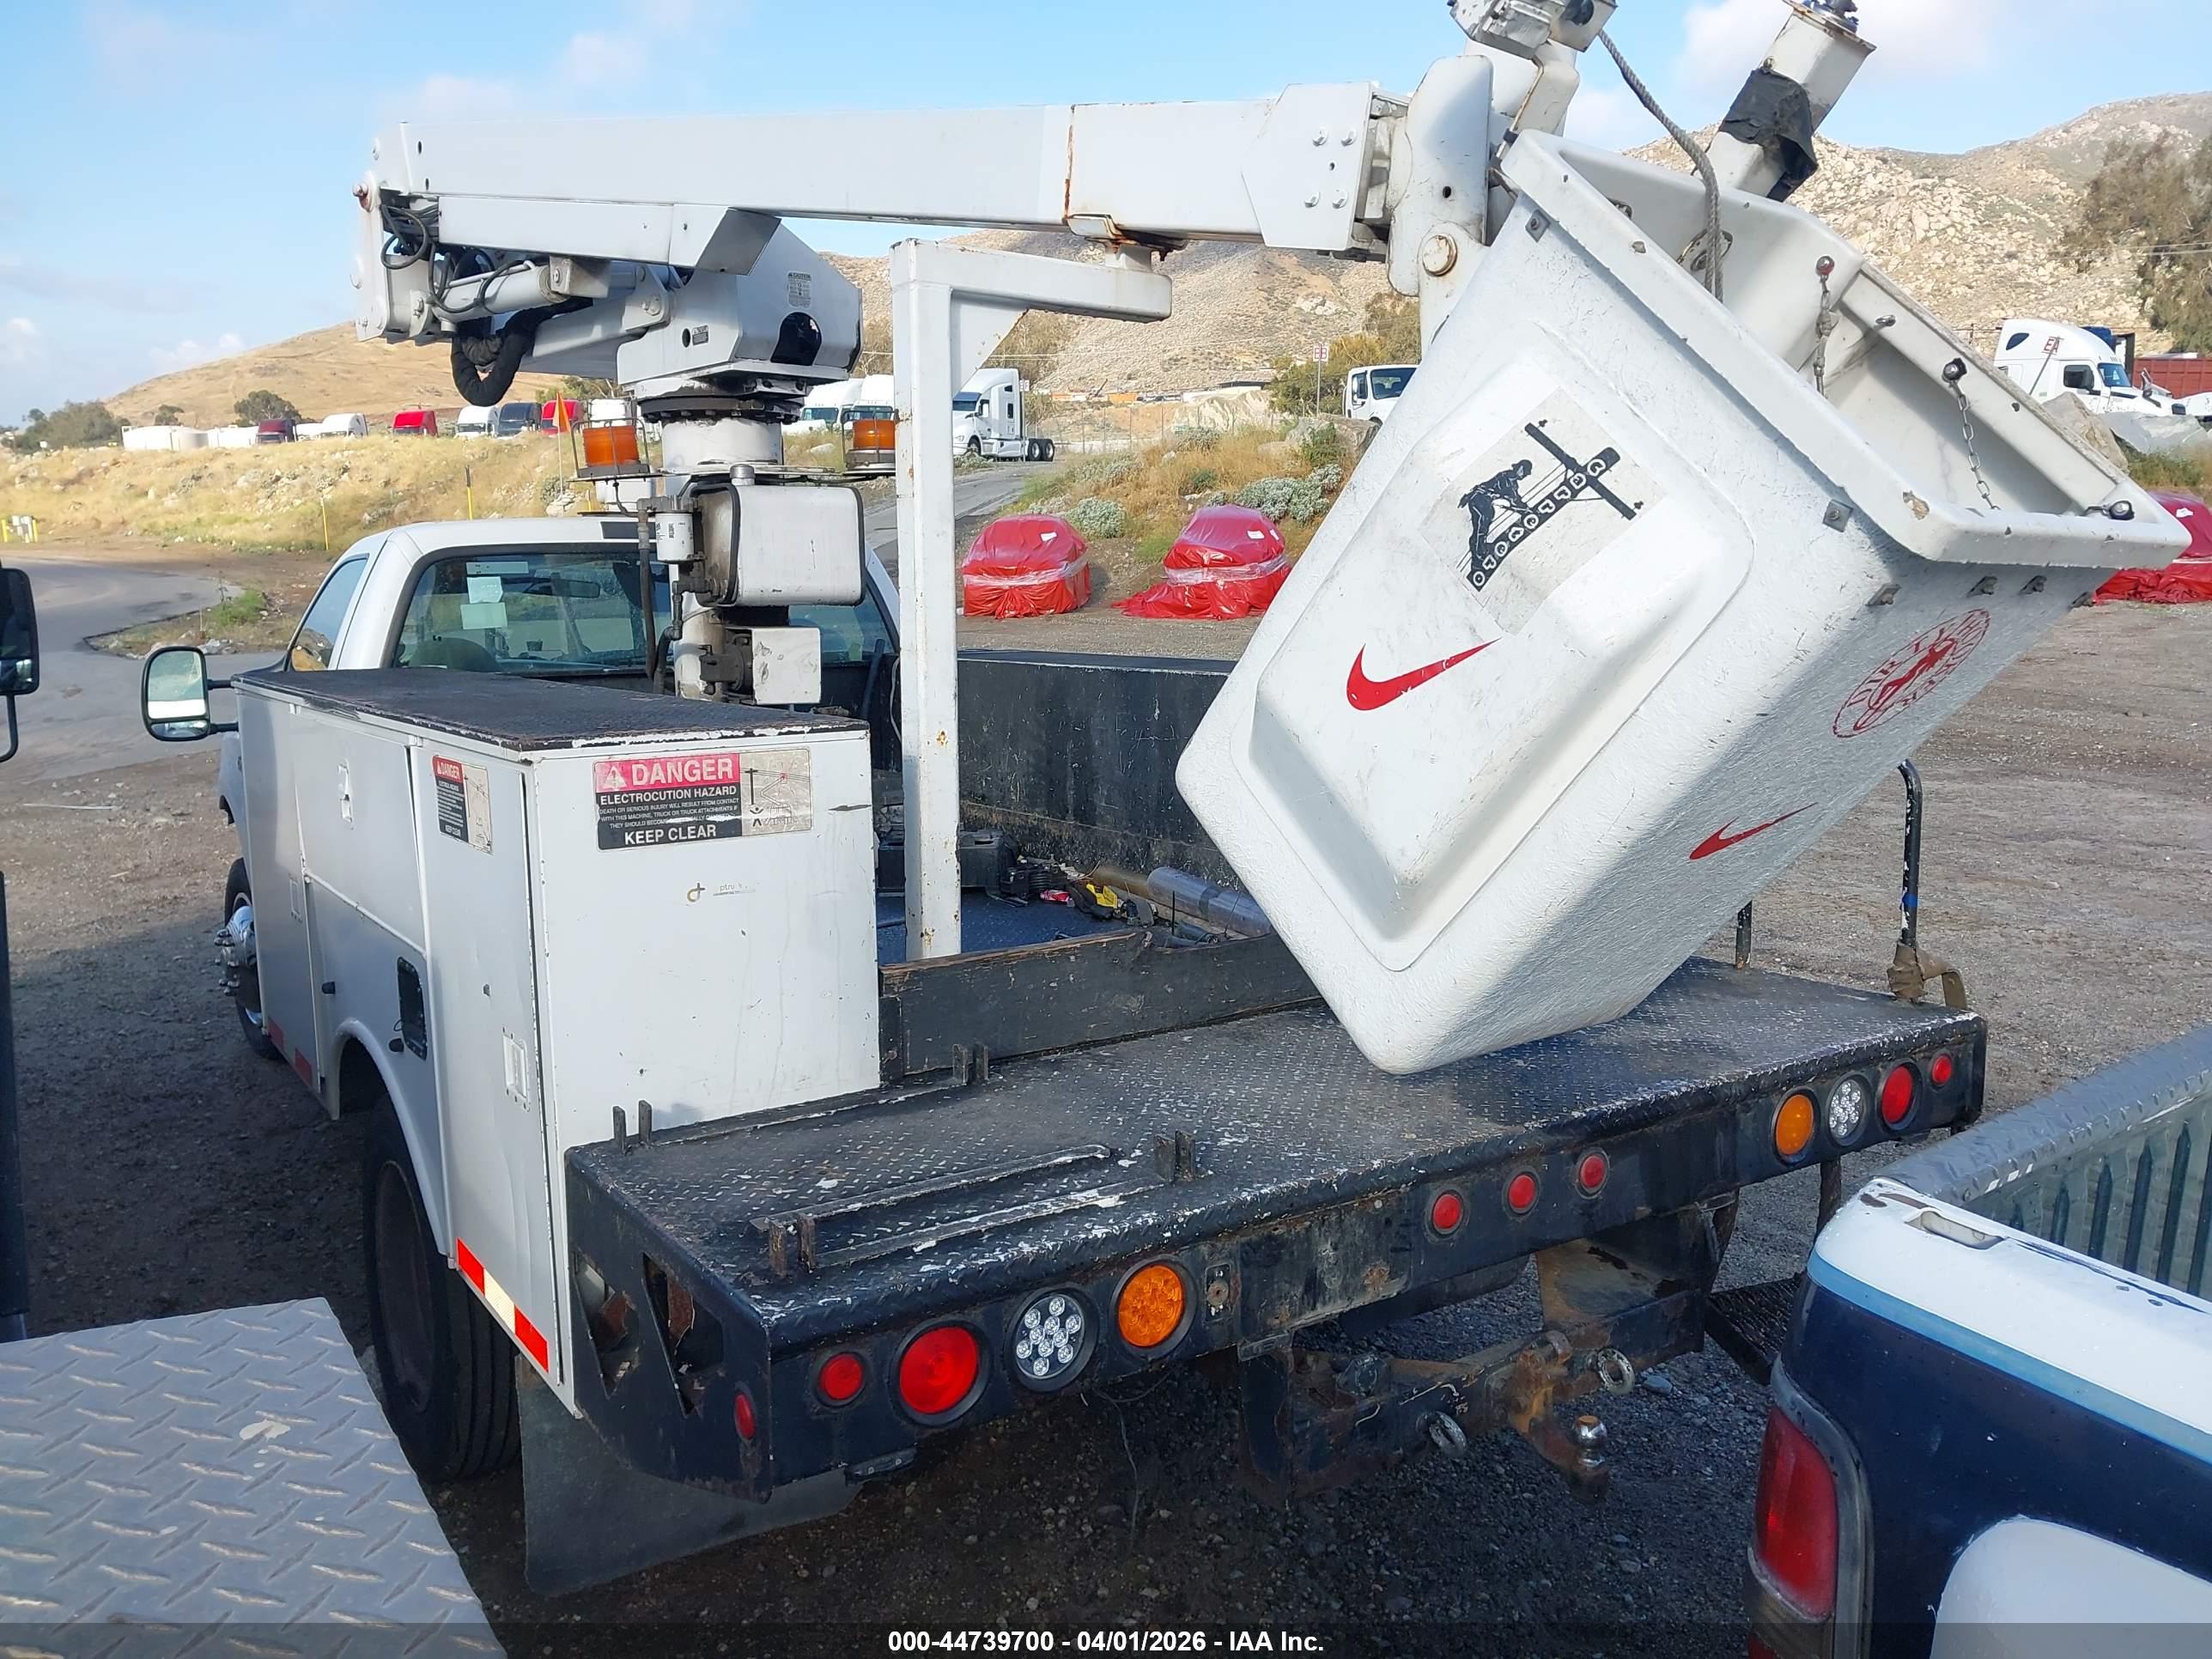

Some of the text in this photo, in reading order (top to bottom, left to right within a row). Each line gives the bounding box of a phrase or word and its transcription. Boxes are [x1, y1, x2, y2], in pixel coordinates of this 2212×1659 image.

[631, 757, 733, 787] DANGER
[600, 785, 737, 805] ELECTROCUTION HAZARD
[716, 797, 739, 805] CONTACT
[697, 804, 734, 813] ATTACHMENTS
[623, 819, 647, 828] SHOULD
[624, 824, 716, 846] KEEP CLEAR
